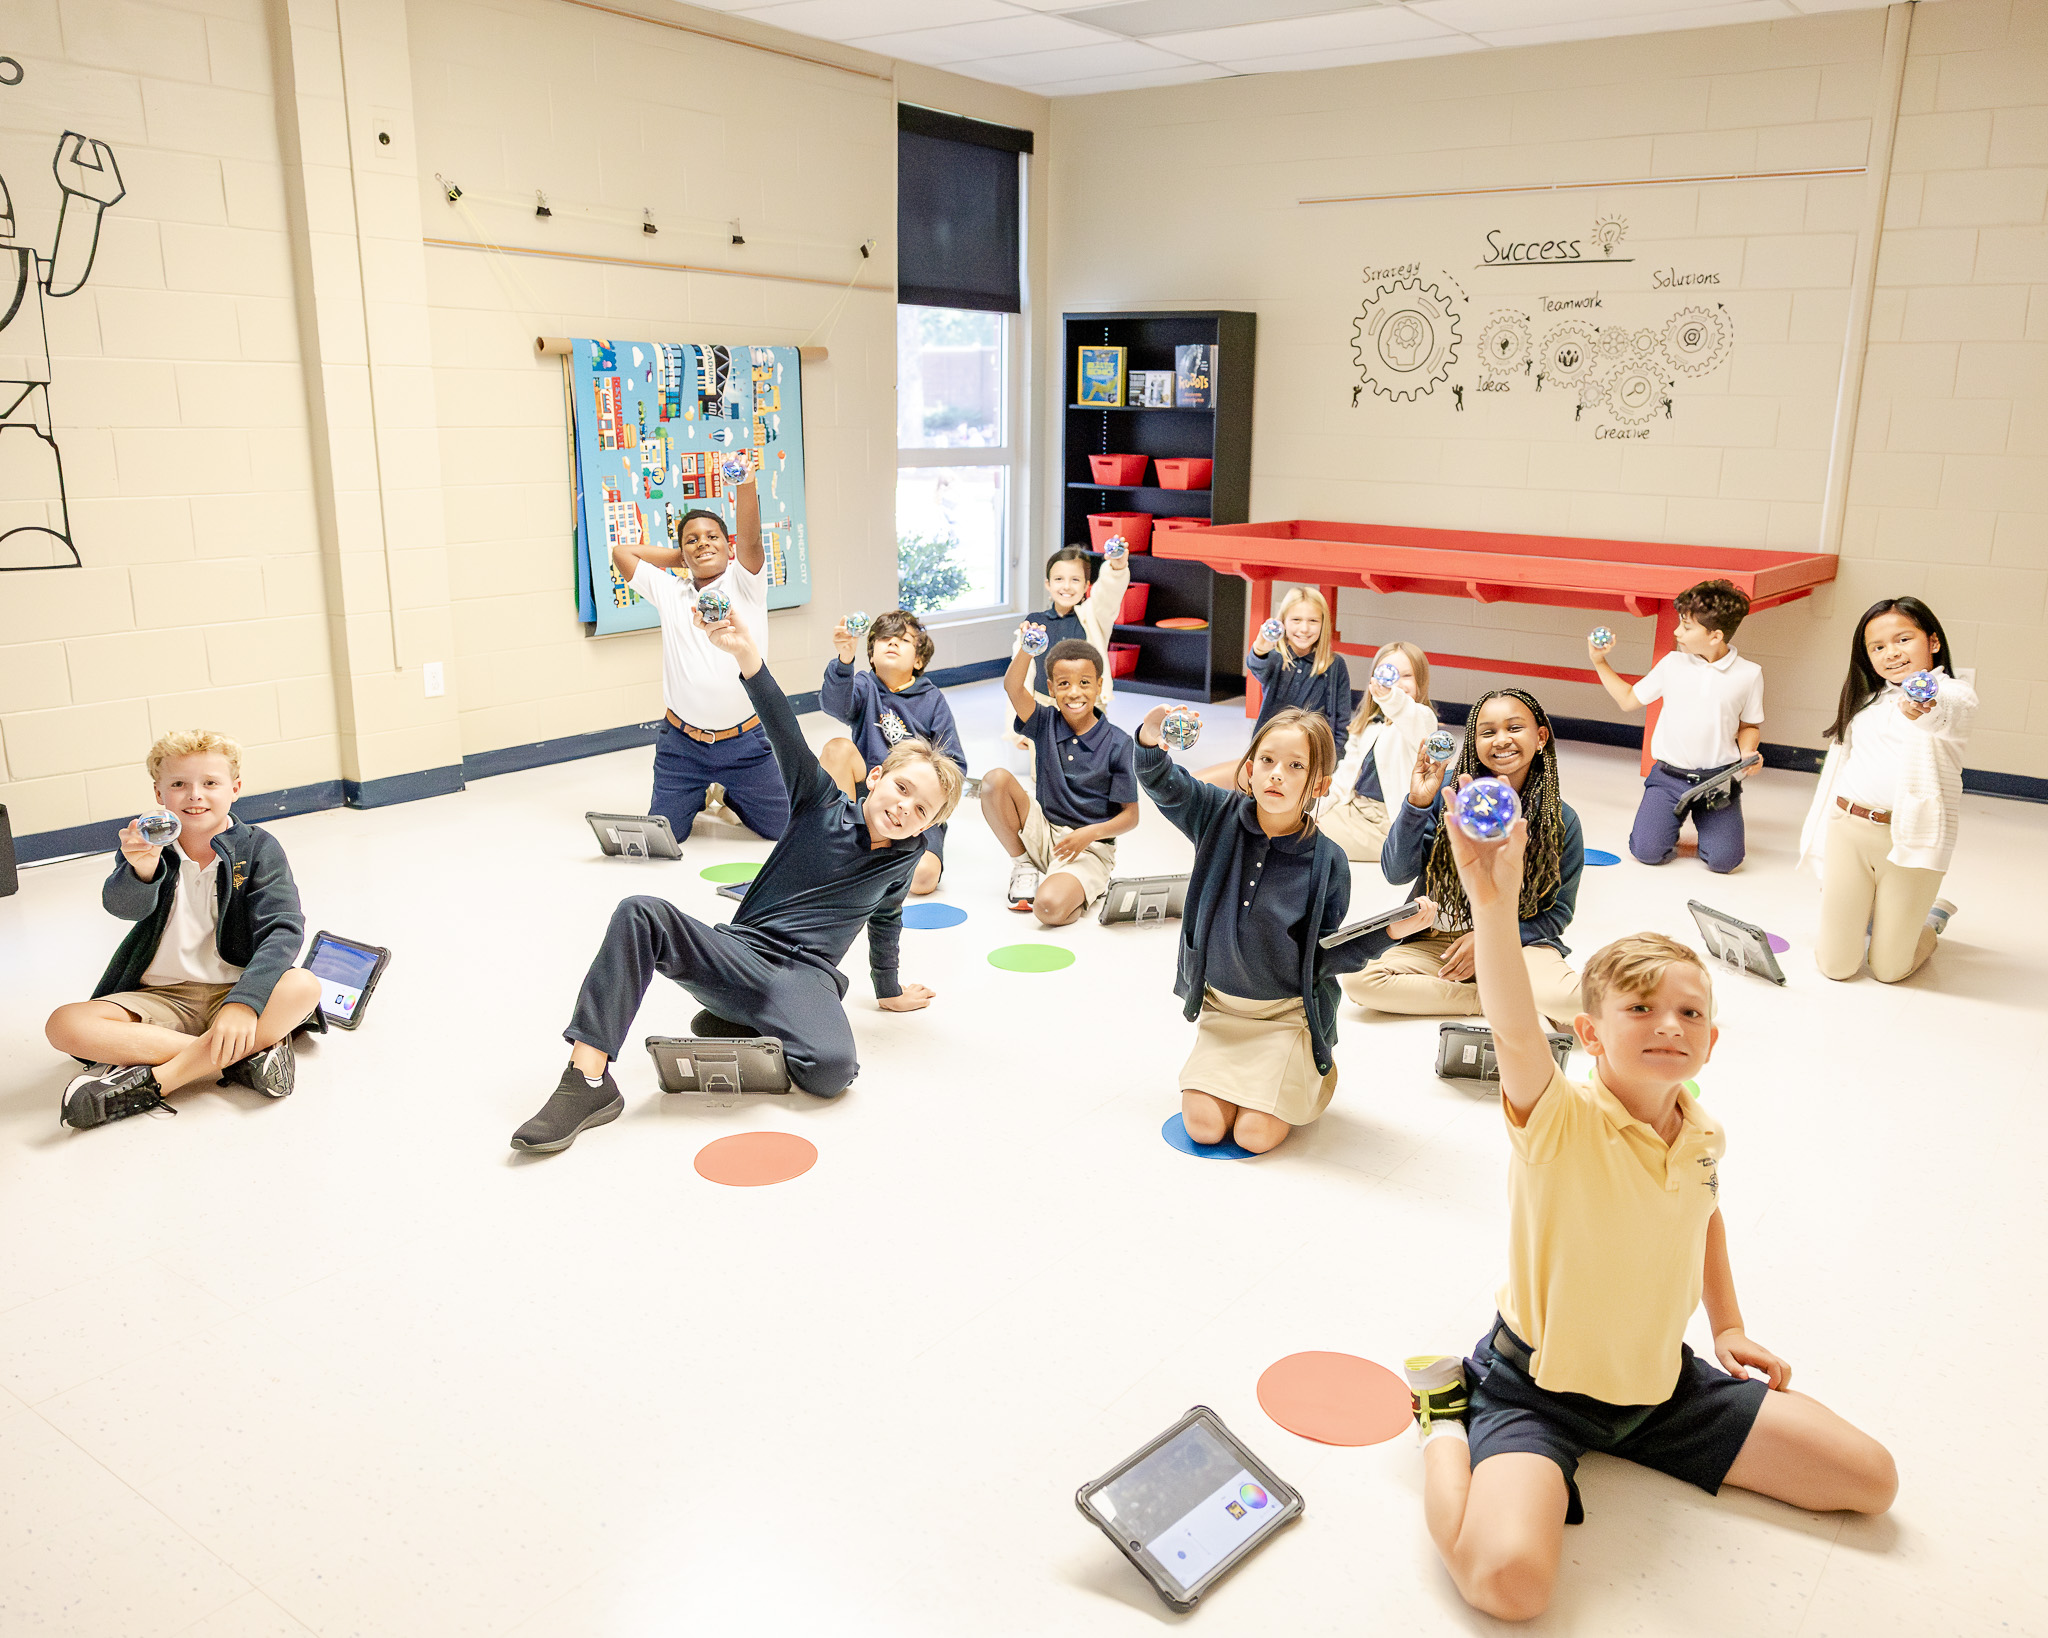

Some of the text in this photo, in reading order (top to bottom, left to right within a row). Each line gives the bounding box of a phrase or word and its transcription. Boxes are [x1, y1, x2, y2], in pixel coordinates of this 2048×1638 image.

[1483, 229, 1581, 263] Success
[1362, 262, 1421, 284] Strategy
[1652, 267, 1721, 290] Solutions
[1537, 290, 1603, 312] Teamwork
[702, 344, 716, 385] STADIUM
[1475, 373, 1511, 392] Ideas
[1594, 424, 1651, 440] Creative
[772, 532, 785, 586] AIRPORT
[796, 523, 808, 585] SPHERO CITY
